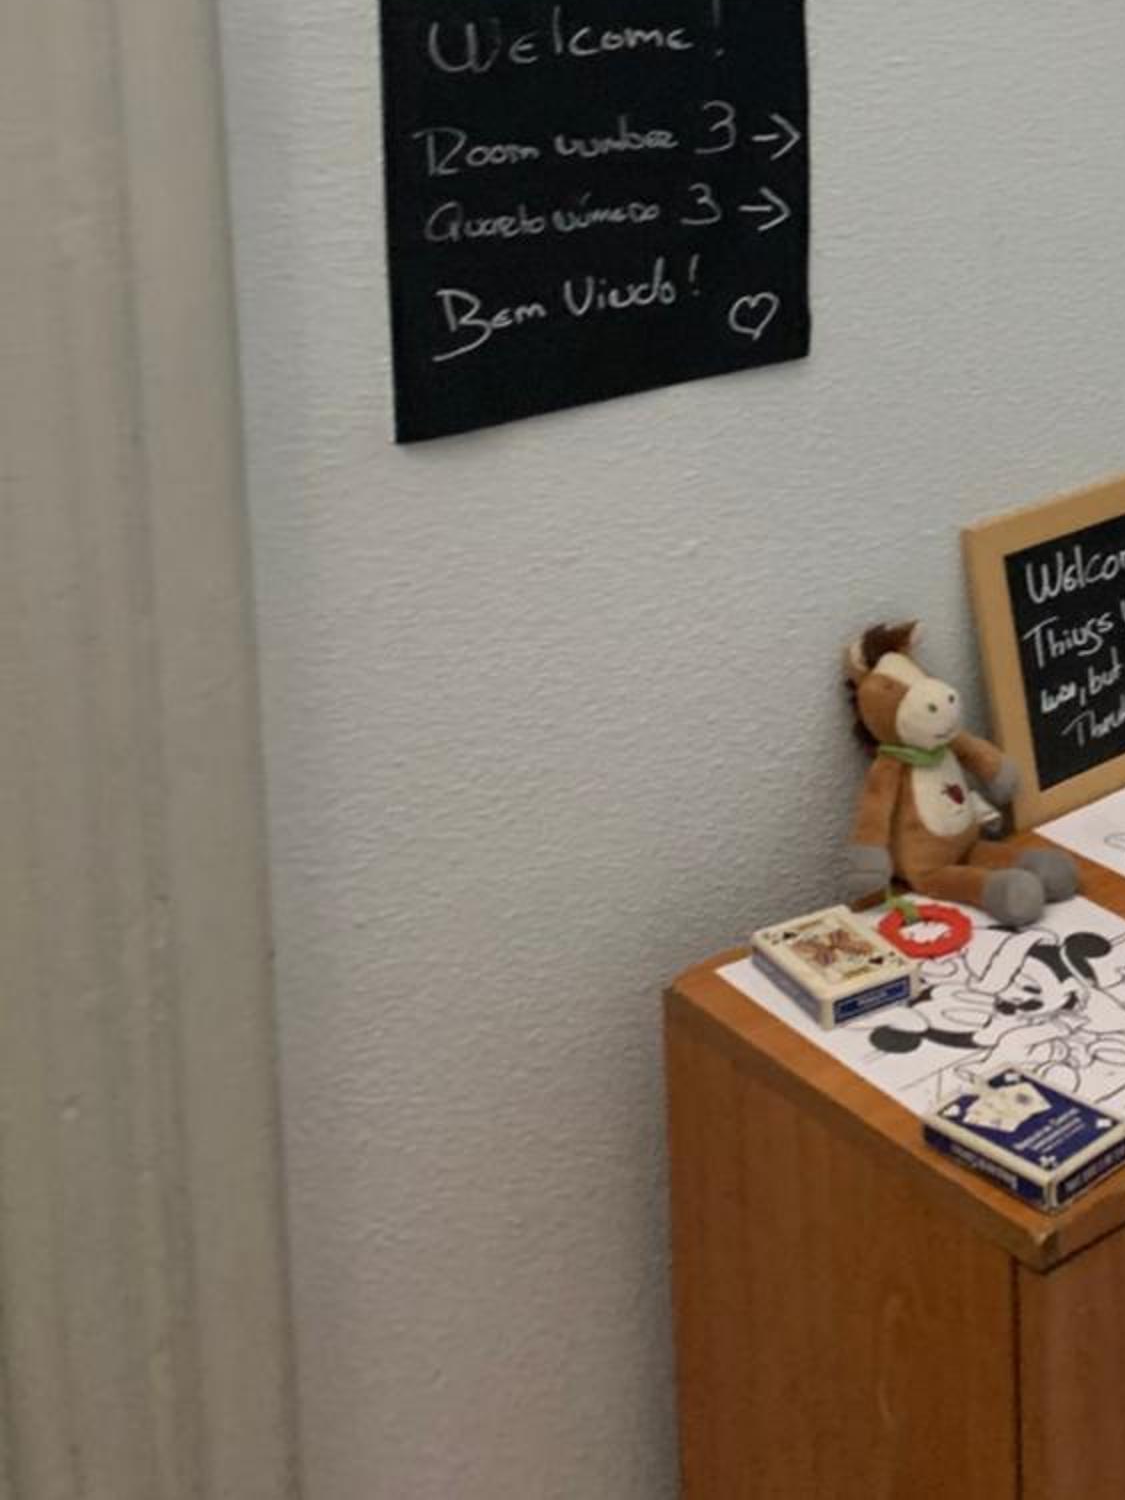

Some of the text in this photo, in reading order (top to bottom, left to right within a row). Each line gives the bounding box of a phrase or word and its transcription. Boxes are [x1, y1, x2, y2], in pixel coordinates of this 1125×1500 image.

[412, 126, 541, 176] Room
[695, 100, 737, 155] 3
[681, 183, 721, 225] 3
[432, 288, 547, 363] Bem
[1021, 612, 1114, 669] Things
[1087, 645, 1122, 695] but
